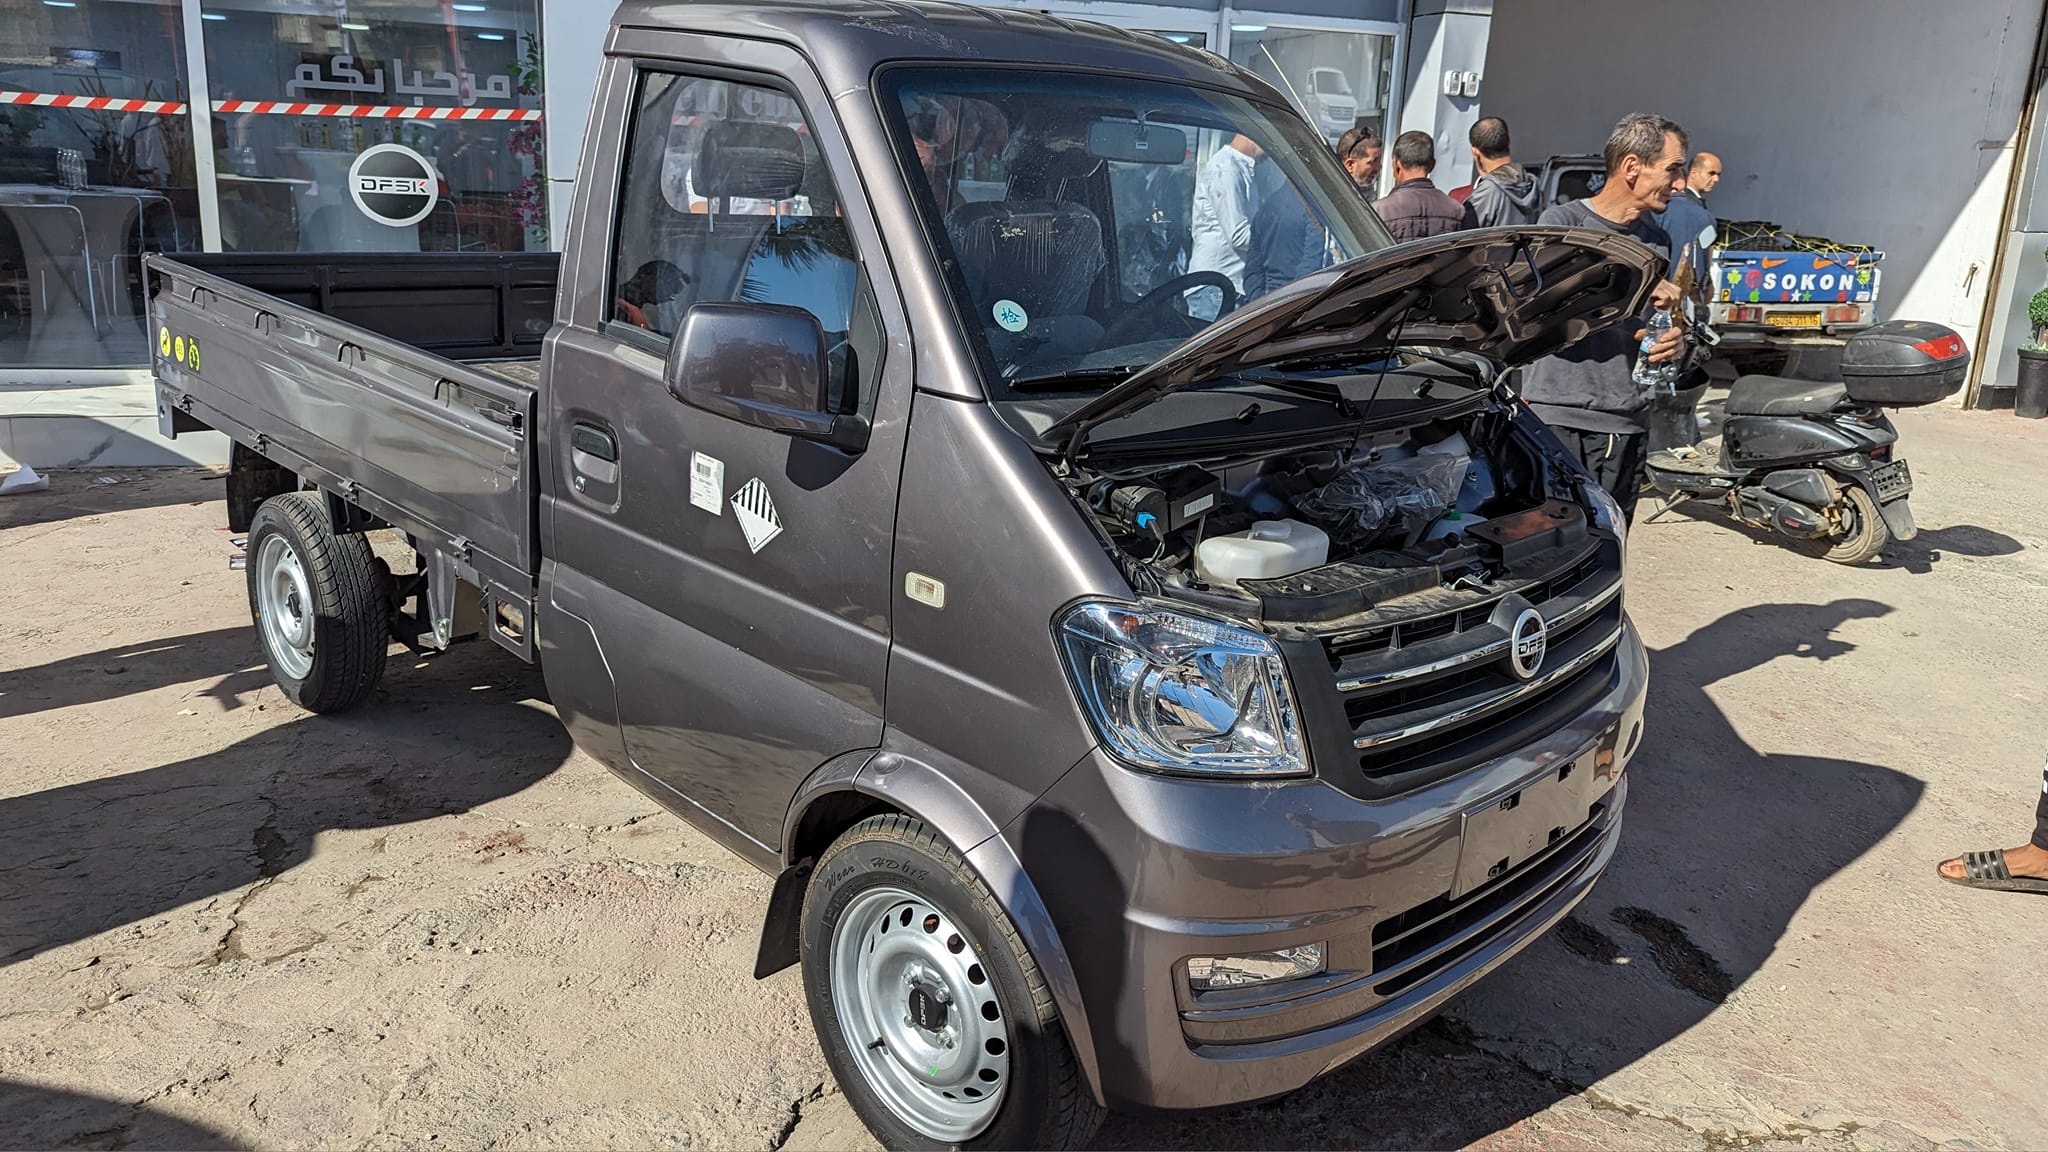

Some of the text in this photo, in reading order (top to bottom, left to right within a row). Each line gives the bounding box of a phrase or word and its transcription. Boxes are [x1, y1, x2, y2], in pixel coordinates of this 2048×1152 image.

[393, 58, 512, 107] مرحبا
[361, 178, 427, 194] DFSK
[1762, 272, 1854, 291] SOKON
